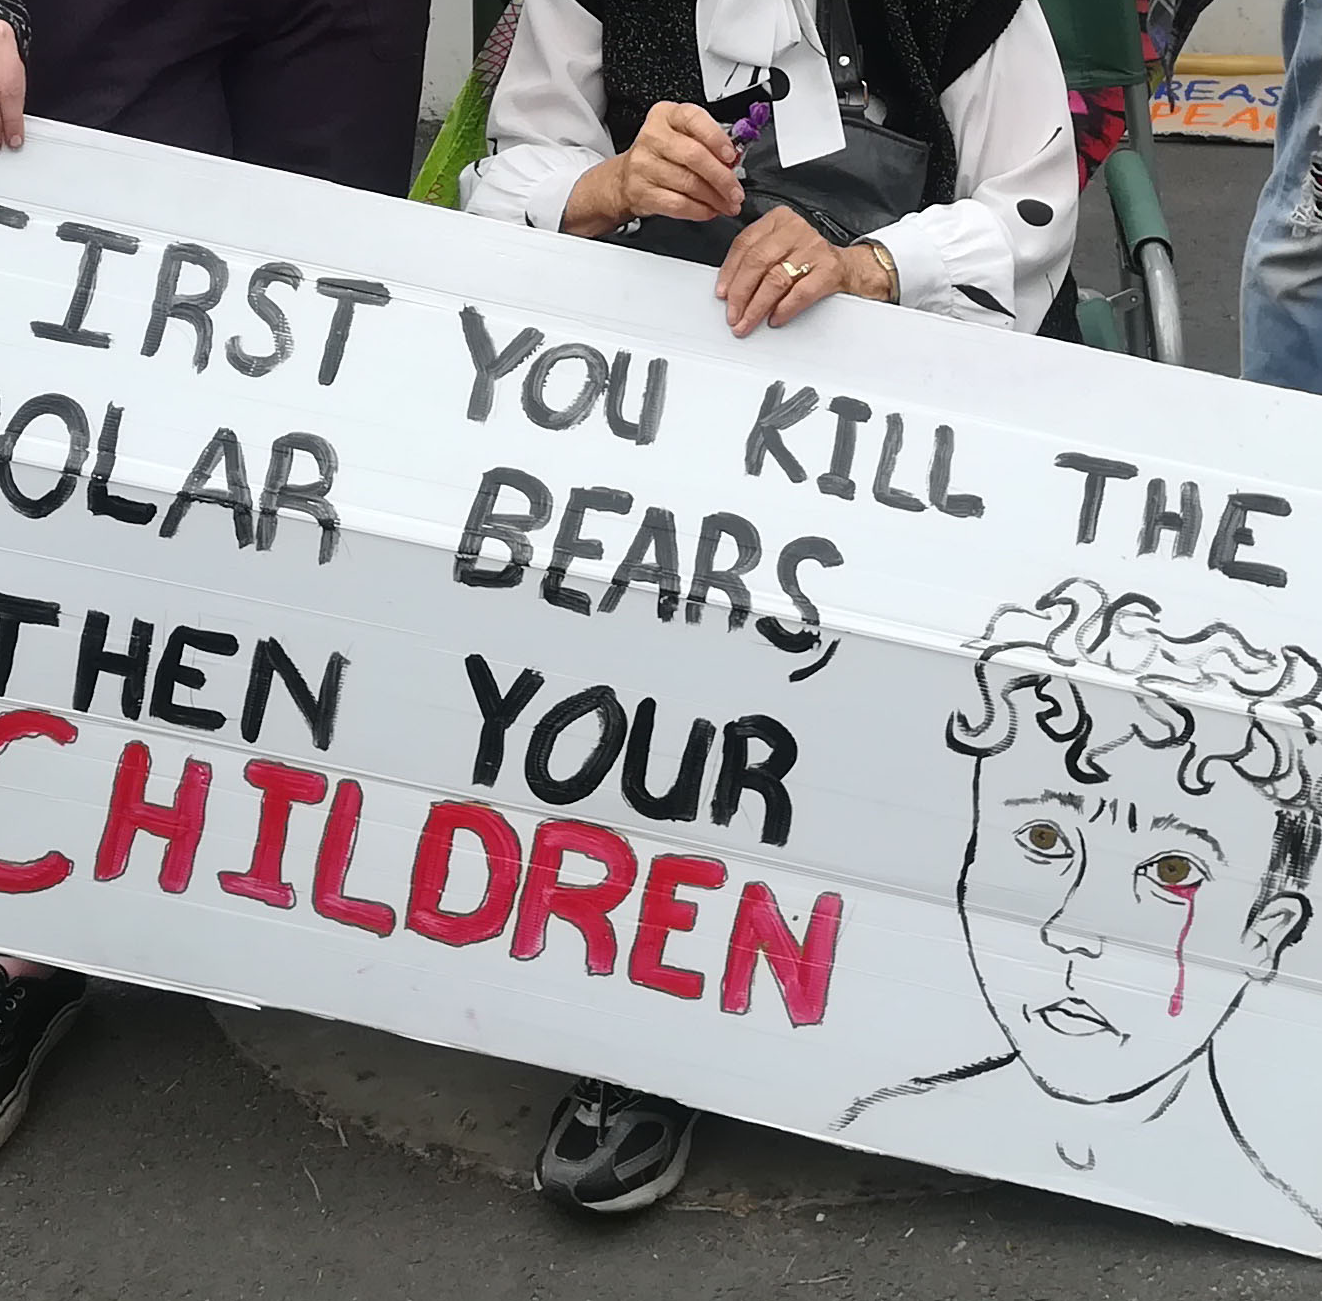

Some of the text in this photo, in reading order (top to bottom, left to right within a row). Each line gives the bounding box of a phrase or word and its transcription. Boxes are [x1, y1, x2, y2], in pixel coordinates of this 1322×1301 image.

[1154, 80, 1283, 107] REAS
[460, 303, 669, 445] YOU
[745, 381, 985, 519] KILL
[1054, 452, 1293, 589] THE
[452, 466, 845, 684] BEARS,
[464, 652, 798, 847] YOUR
